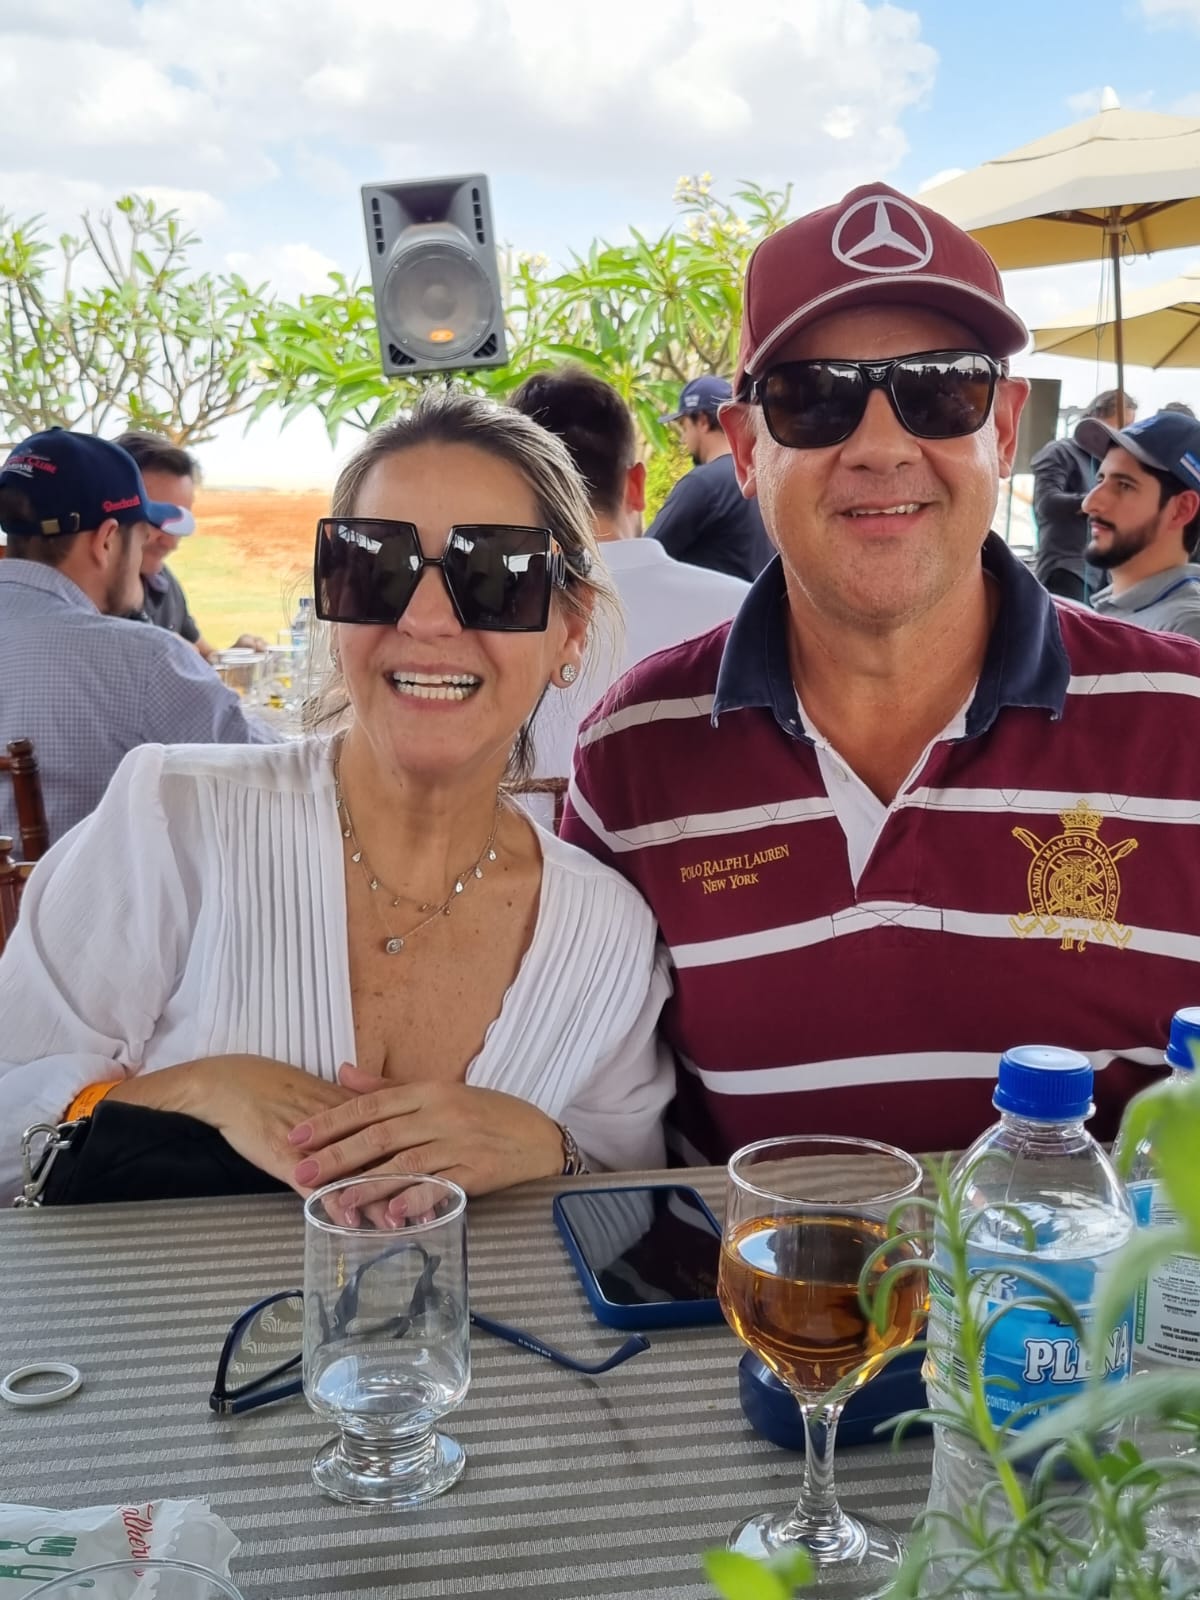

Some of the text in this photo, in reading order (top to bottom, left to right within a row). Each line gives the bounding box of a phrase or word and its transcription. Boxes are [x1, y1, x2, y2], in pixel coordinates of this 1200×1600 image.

[680, 844, 790, 883] POLO RALPH LAUREN
[702, 872, 760, 894] NEW YORK
[1033, 860, 1046, 900] SADDLE
[1043, 836, 1082, 859] MAKER
[1085, 838, 1094, 850] &
[120, 1503, 154, 1578] alher
